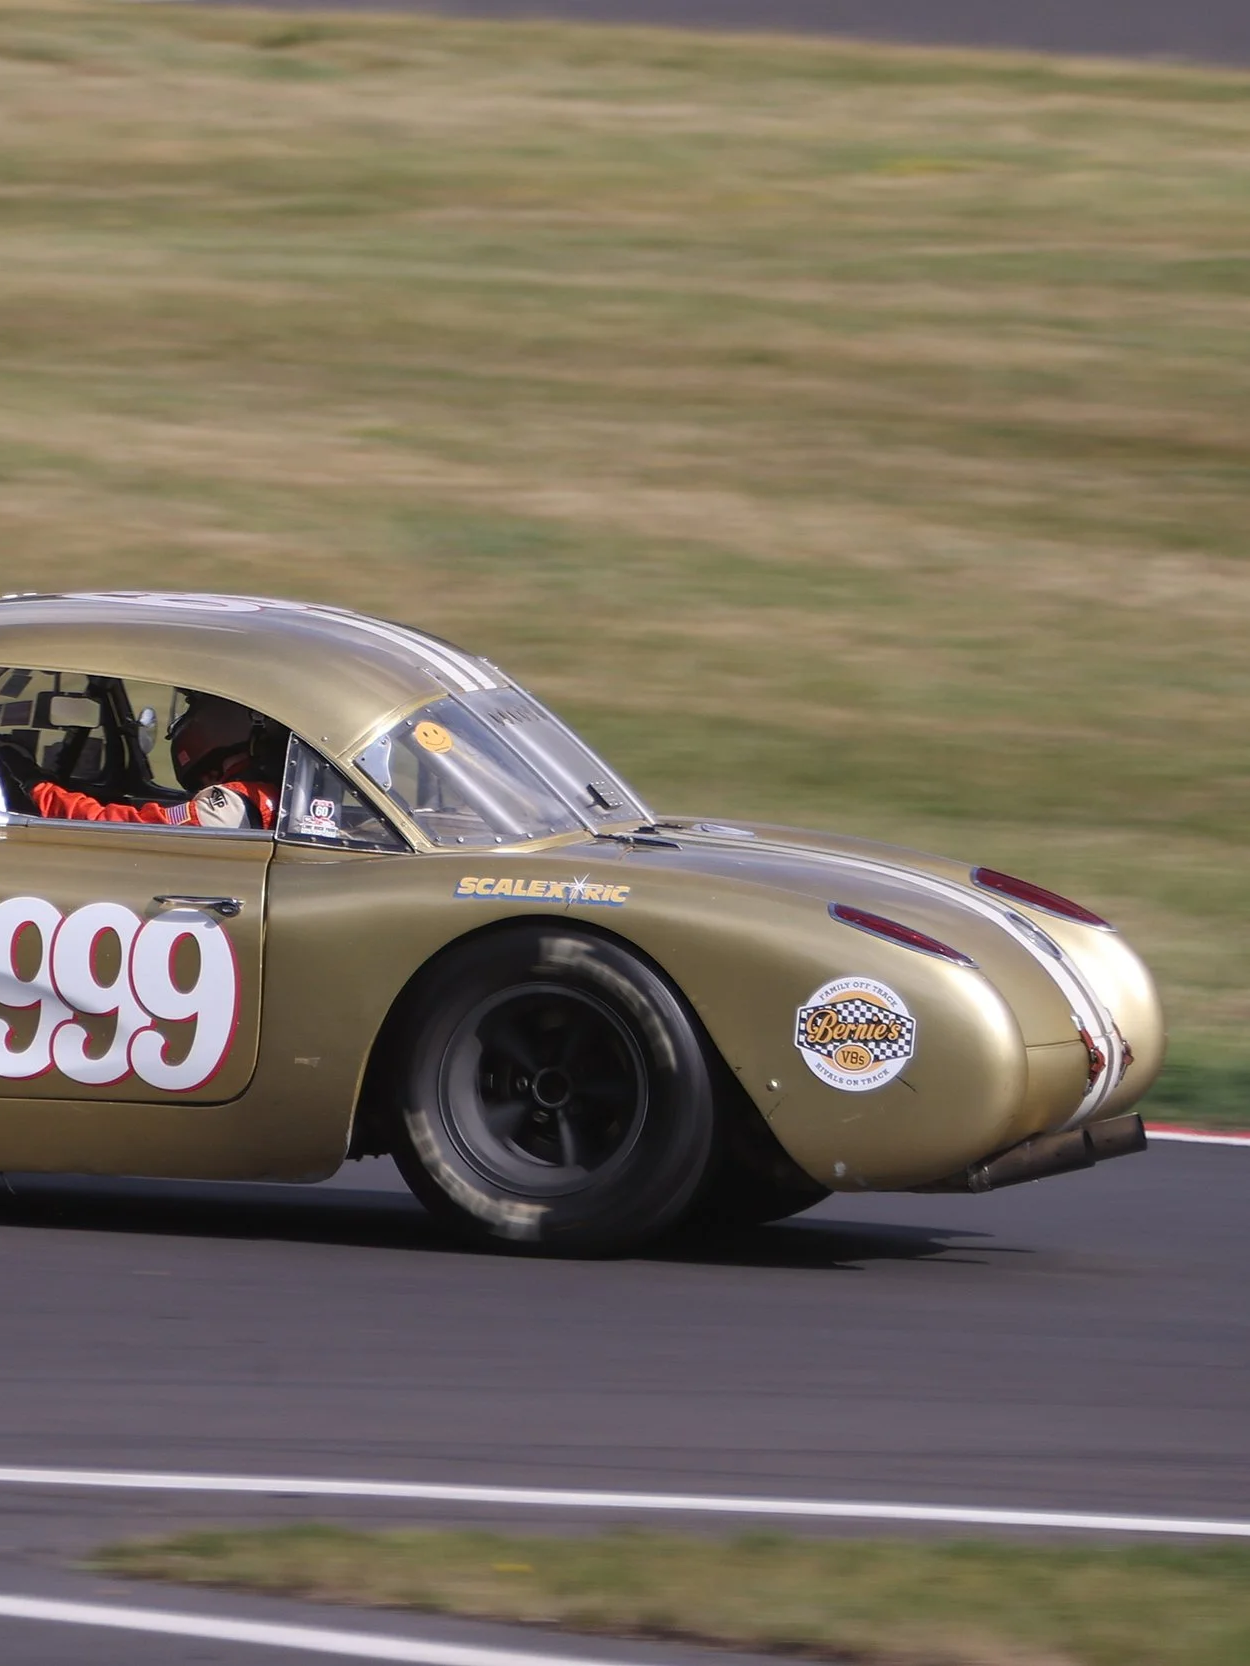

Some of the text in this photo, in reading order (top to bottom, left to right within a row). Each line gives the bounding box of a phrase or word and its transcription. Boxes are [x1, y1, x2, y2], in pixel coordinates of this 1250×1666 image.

[315, 806, 328, 817] 60
[456, 876, 631, 905] SCALEXTRIC
[819, 981, 898, 1007] FAMILY OFF TRACK
[806, 1008, 901, 1043] Bernie's
[815, 1062, 844, 1084] RIVALS
[861, 1068, 890, 1085] TRACK
